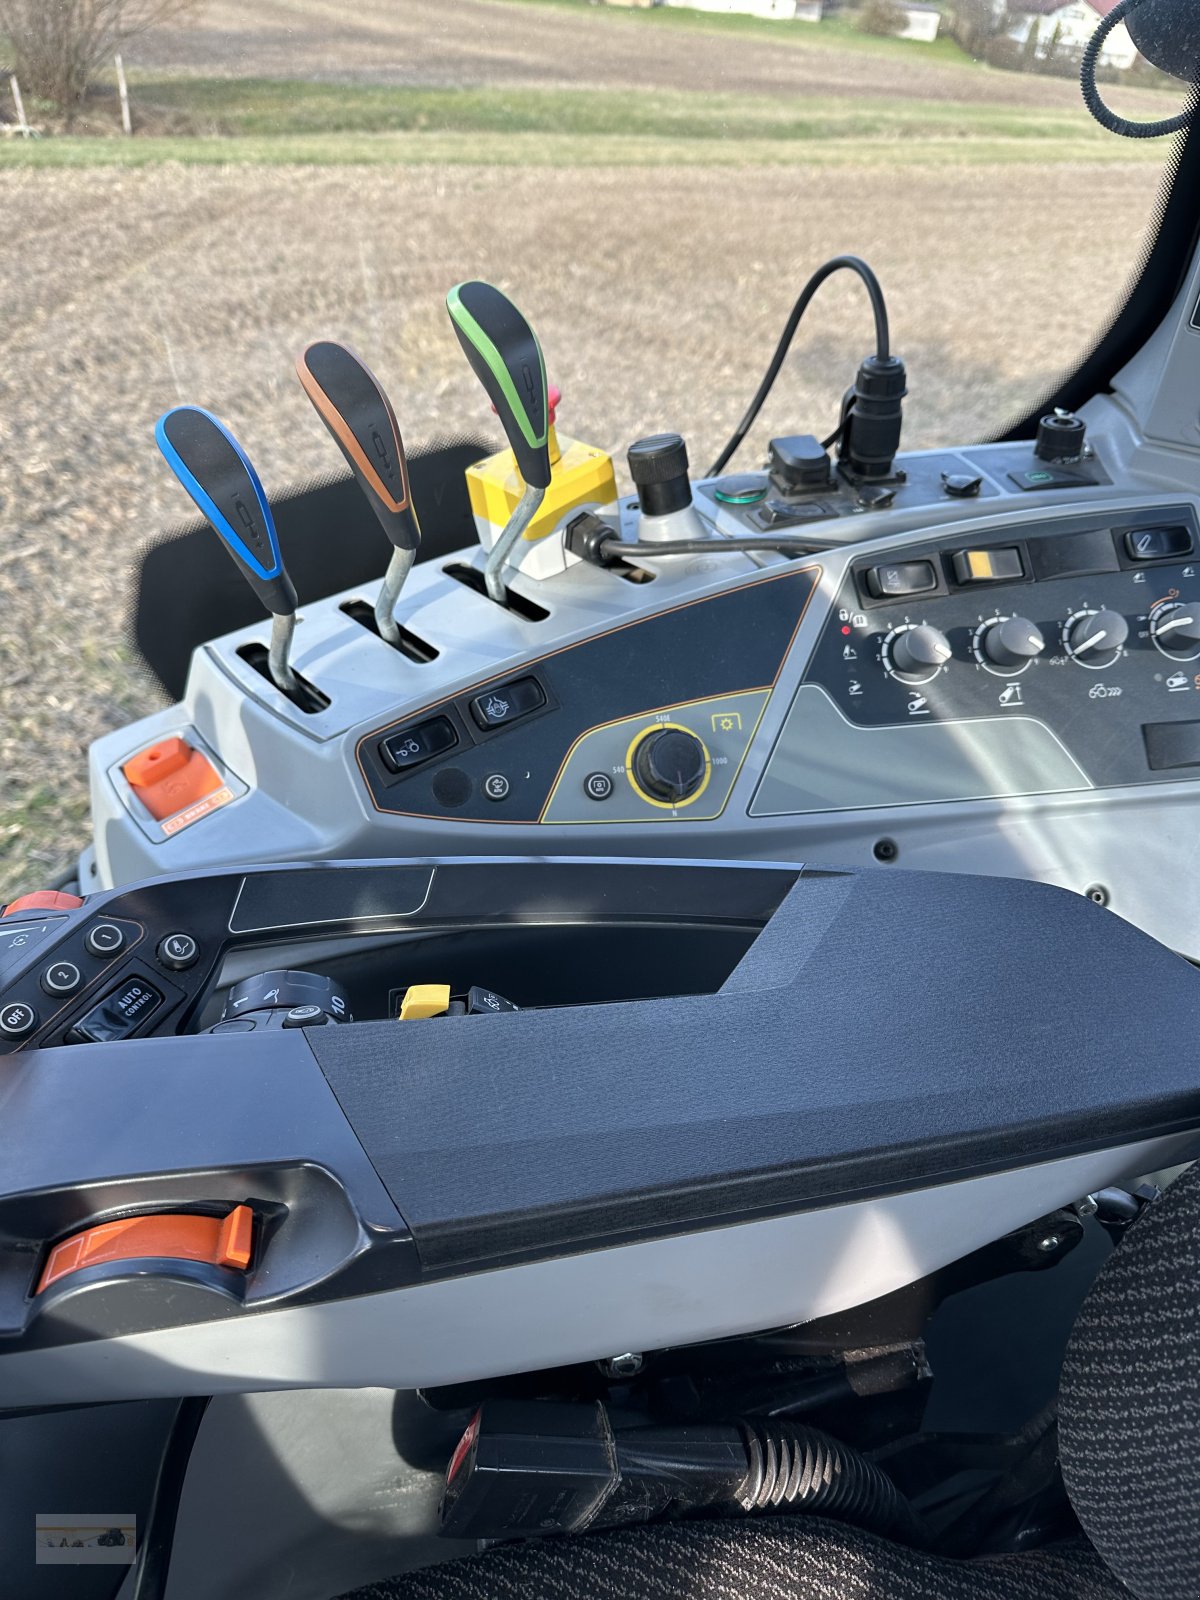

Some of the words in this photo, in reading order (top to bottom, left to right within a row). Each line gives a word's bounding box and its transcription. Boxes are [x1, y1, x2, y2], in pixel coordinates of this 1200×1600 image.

[711, 757, 728, 765] 1000
[612, 766, 625, 774] 540
[58, 971, 69, 980] 2
[118, 987, 142, 1009] AUTO
[125, 992, 153, 1017] CONTROL
[331, 995, 345, 1015] 10
[7, 1008, 25, 1025] OFF
